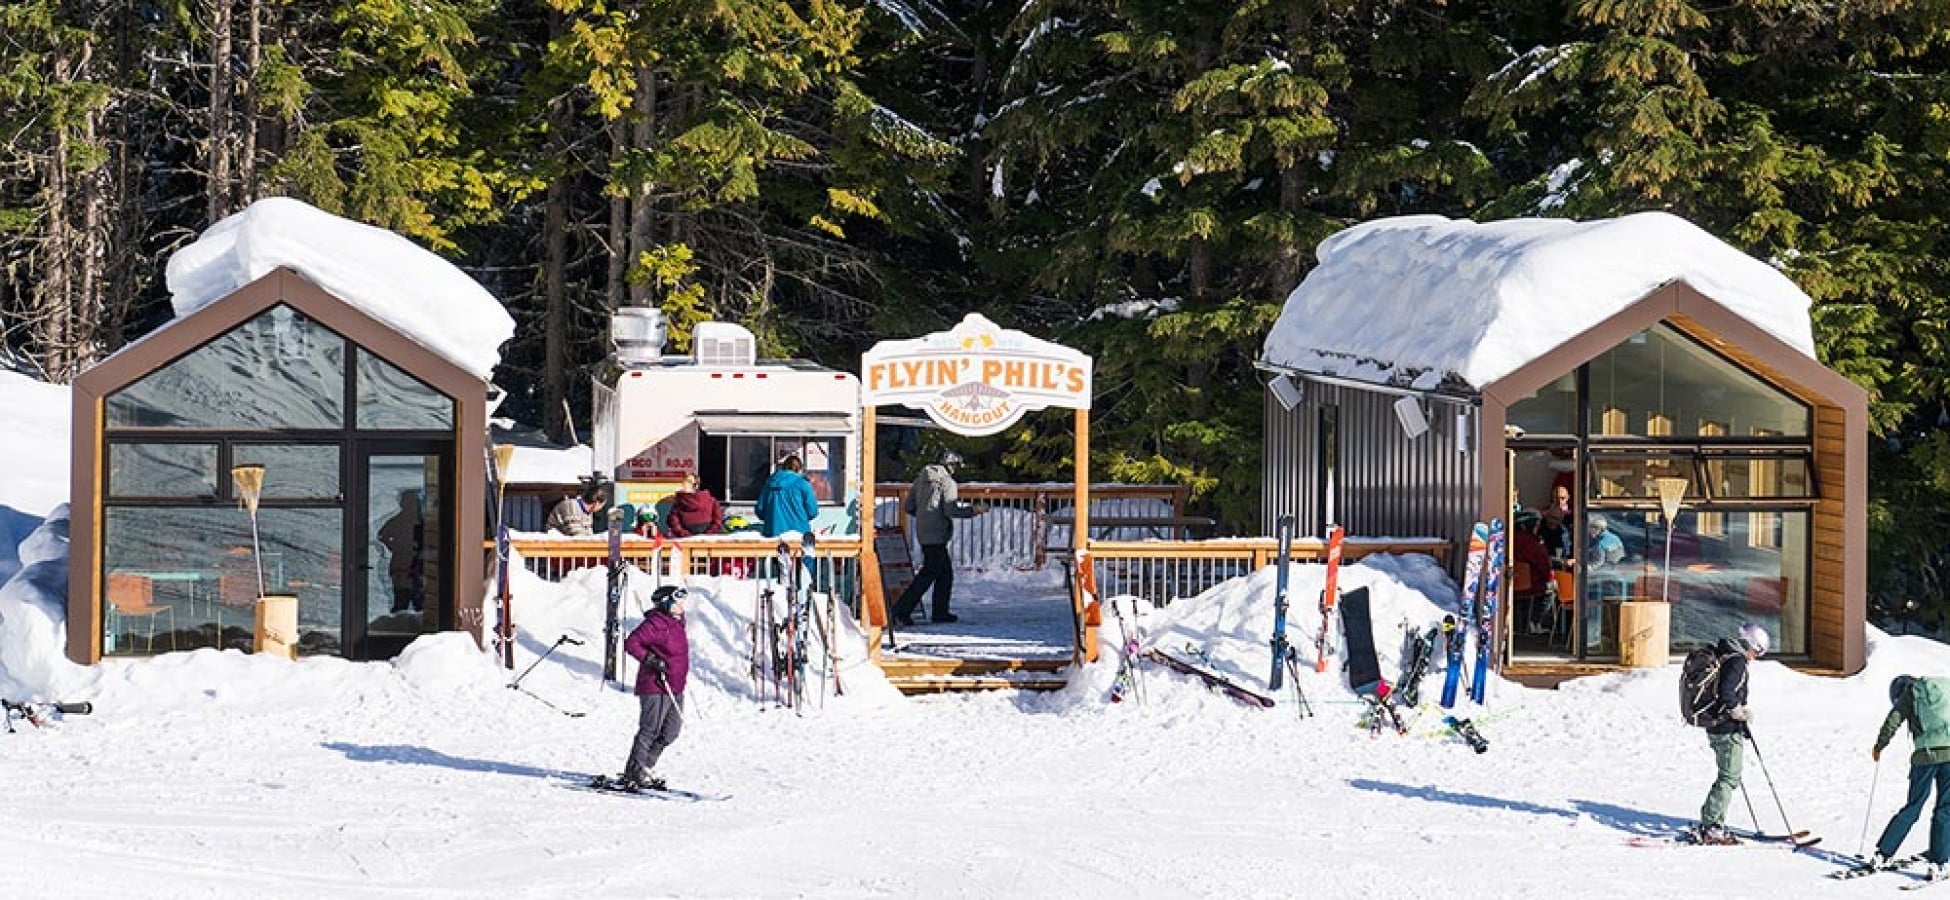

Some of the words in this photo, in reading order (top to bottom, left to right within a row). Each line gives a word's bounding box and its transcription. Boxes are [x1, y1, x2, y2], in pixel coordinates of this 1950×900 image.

[869, 358, 970, 391] FLYIN'
[982, 359, 1085, 393] PHIL'S
[939, 401, 1012, 424] HANGOUT
[625, 458, 652, 468] TACO
[666, 457, 694, 468] ROJO
